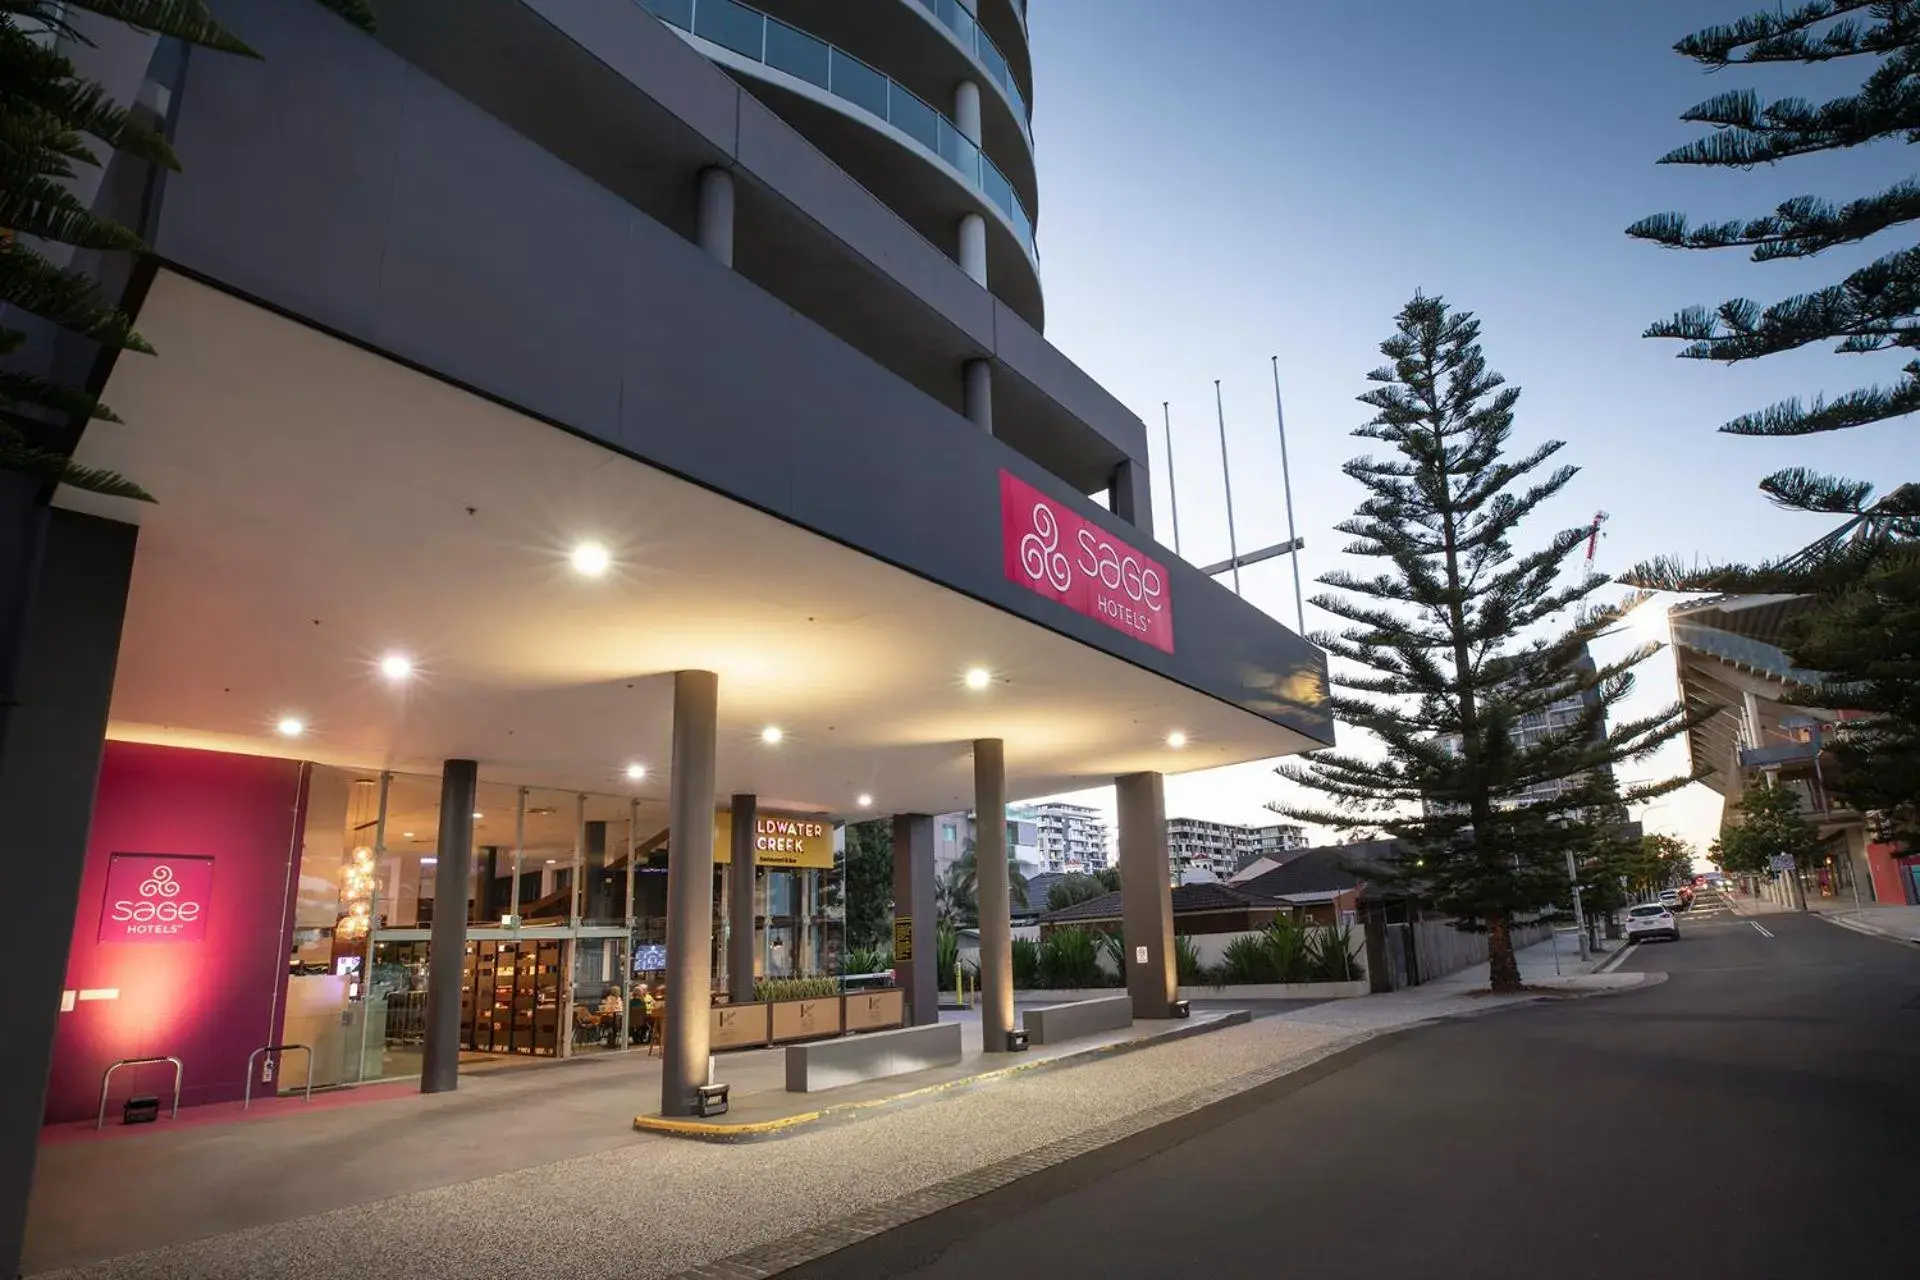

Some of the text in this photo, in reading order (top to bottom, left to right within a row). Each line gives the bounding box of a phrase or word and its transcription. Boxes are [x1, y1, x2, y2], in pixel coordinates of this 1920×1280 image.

[1097, 594, 1147, 632] HOTELS
[757, 820, 822, 837] LDWATER
[757, 836, 804, 852] CREEK
